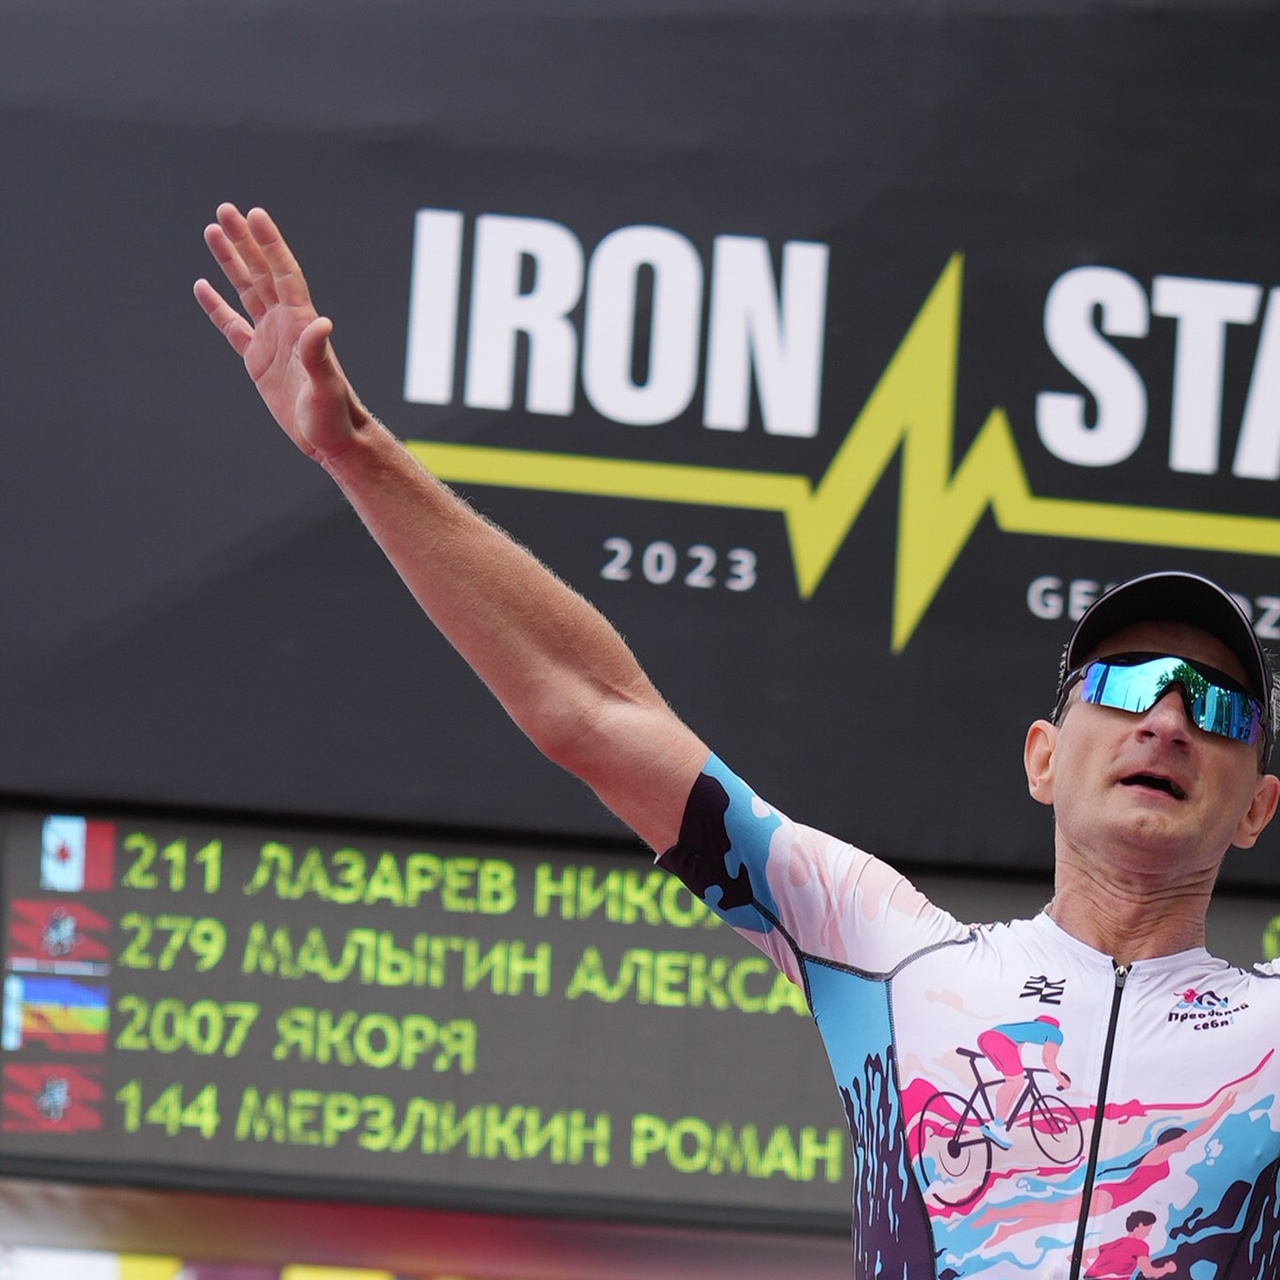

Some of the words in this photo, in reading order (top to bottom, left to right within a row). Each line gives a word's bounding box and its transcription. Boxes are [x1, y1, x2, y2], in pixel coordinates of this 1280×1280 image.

[404, 208, 830, 437] IRON
[601, 537, 759, 591] 2023
[121, 833, 222, 895] 211
[243, 840, 517, 914] ЛАЗАРЕВ
[533, 862, 724, 929] НИКО
[118, 914, 226, 973] 279
[240, 921, 552, 999] МАЛЫГИН
[115, 997, 257, 1058] 2007
[273, 1006, 478, 1074] ЯКОРЯ
[113, 1080, 219, 1140] 144
[236, 1085, 610, 1168] МЕРЗЛИКИН
[630, 1115, 843, 1185] РОМАН
